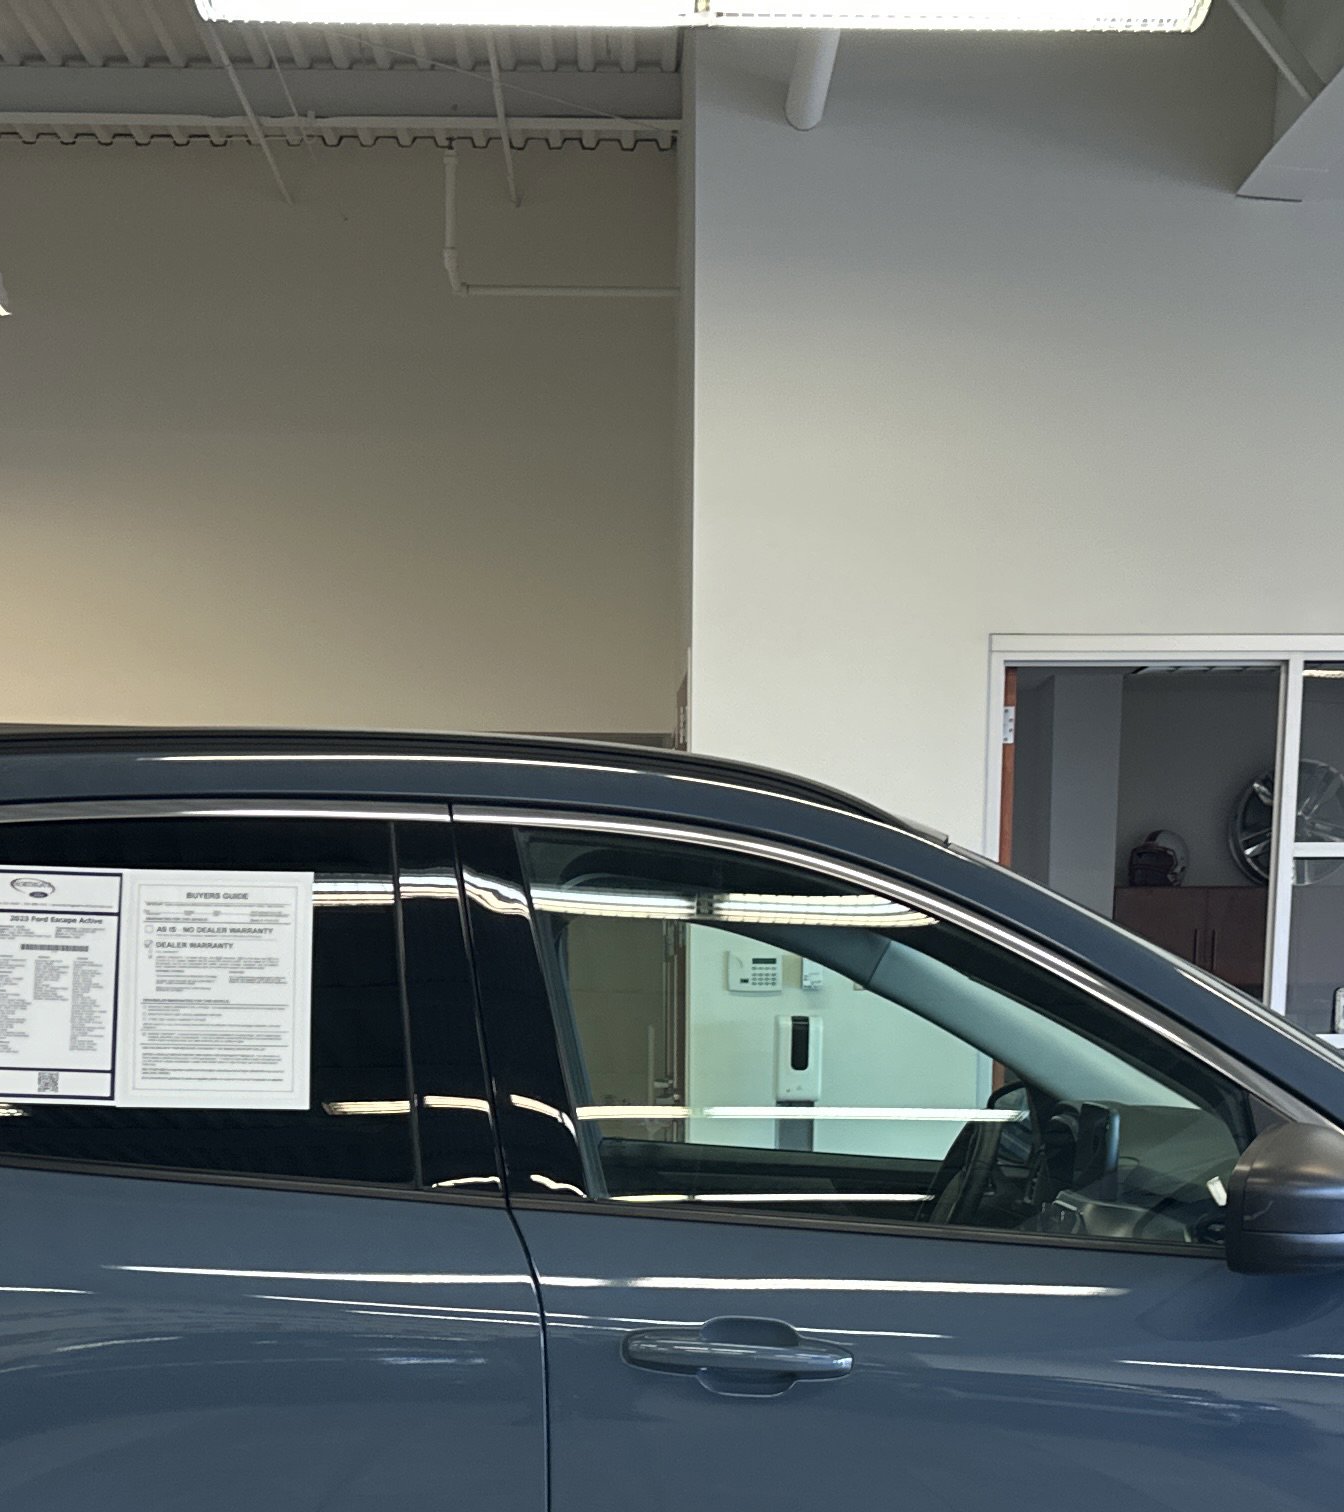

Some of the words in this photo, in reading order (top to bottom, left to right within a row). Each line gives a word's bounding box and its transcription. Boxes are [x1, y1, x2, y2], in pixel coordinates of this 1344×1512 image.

[222, 892, 249, 900] GUIDE
[31, 915, 48, 923] Ford
[50, 916, 77, 924] Escape
